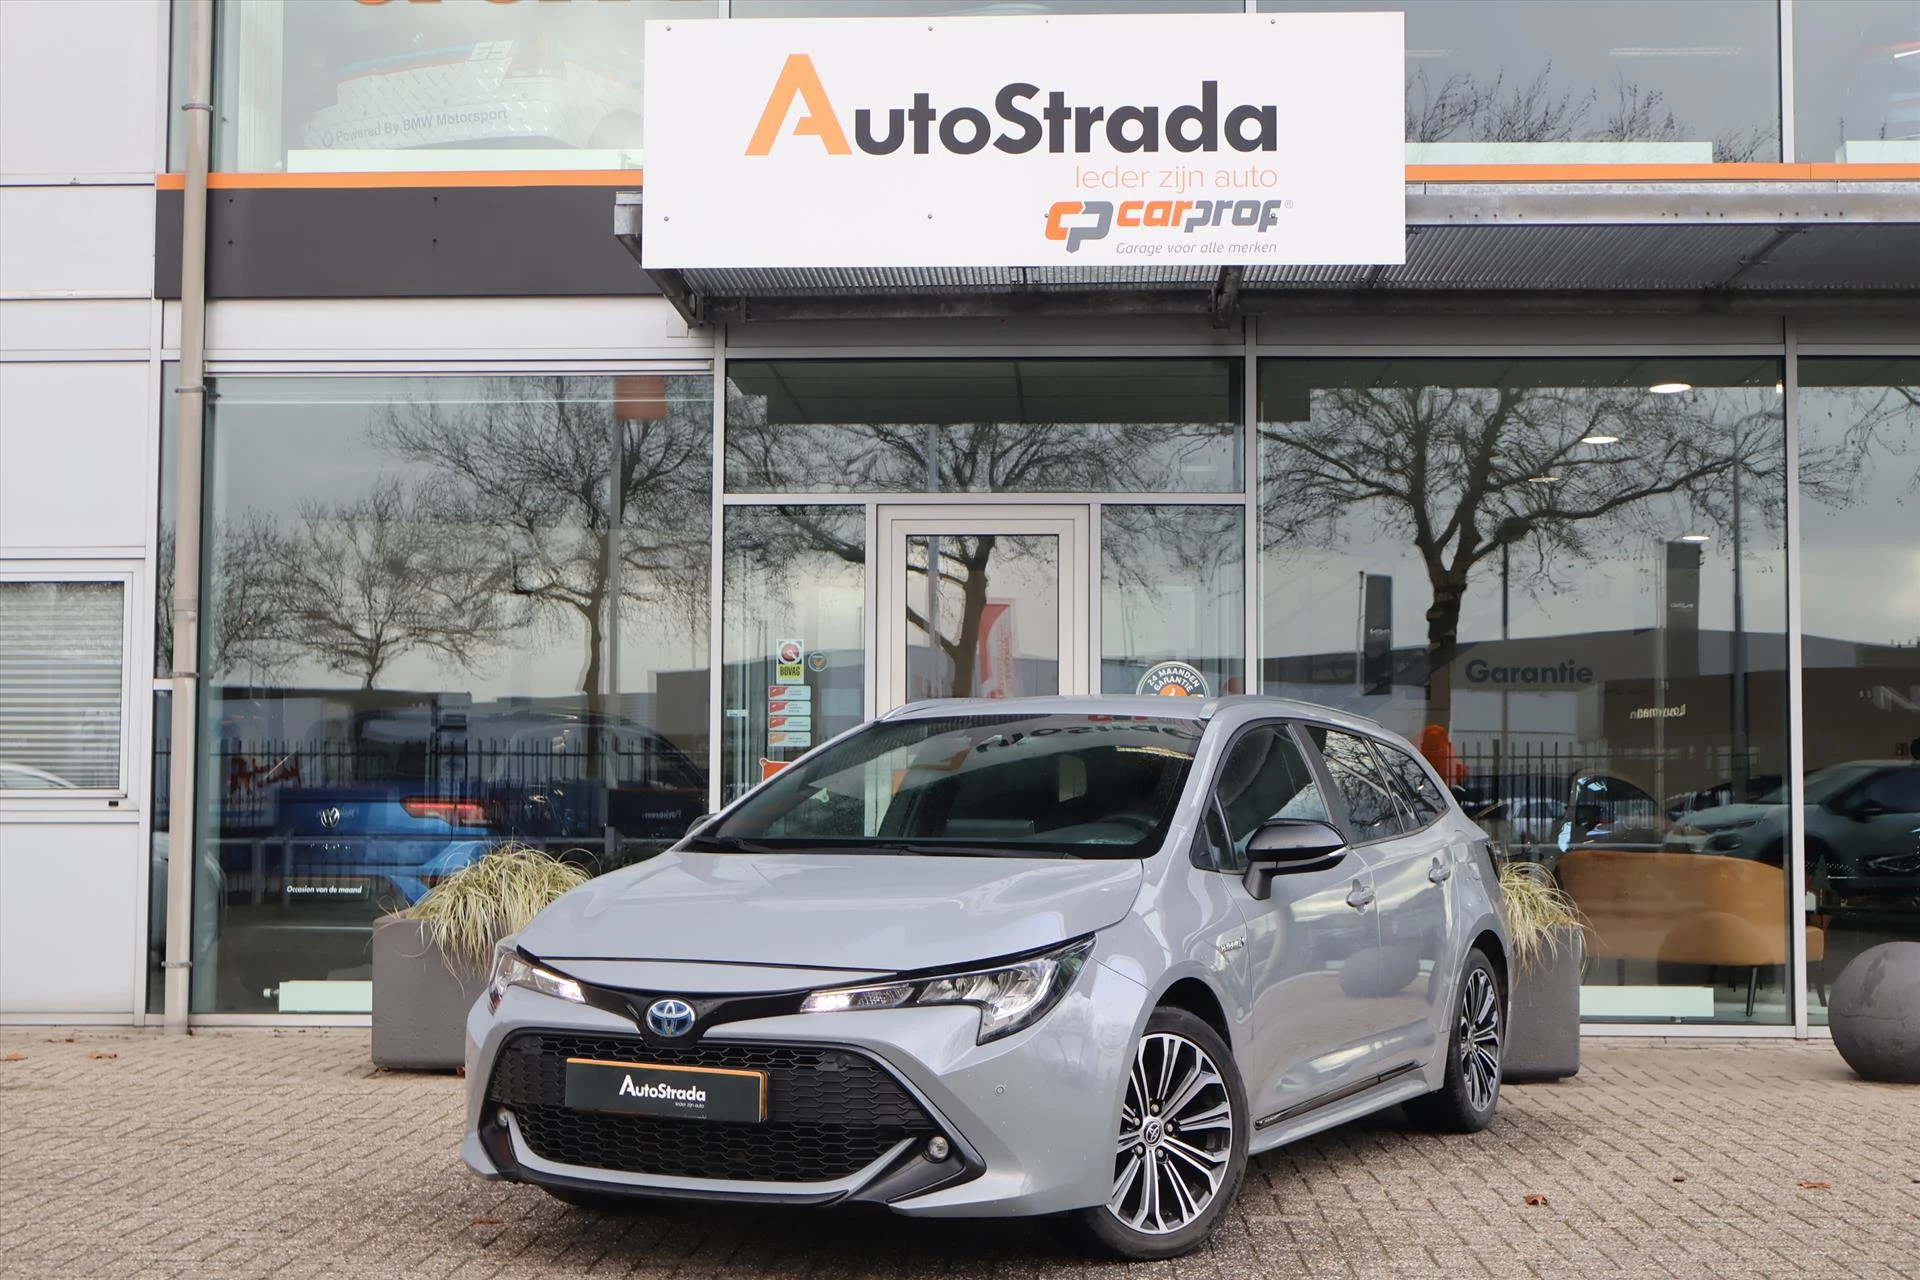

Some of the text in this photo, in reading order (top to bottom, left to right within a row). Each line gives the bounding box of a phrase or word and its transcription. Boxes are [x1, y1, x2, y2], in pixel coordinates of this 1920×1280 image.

[744, 54, 1278, 156] AutoStrada
[336, 109, 508, 143] Powered By BMW Motorsport
[1075, 165, 1278, 194] Ieder zijn auto
[1116, 240, 1277, 257] Garage voor alle merken
[779, 666, 801, 677] BOVAG
[1147, 667, 1201, 687] 24 MAANDEN
[1465, 659, 1593, 683] Garantie
[1153, 675, 1194, 692] GARANTIE
[286, 885, 315, 893] Occasion
[328, 885, 337, 893] de
[338, 885, 362, 893] maand
[619, 1075, 706, 1102] AutoStrada
